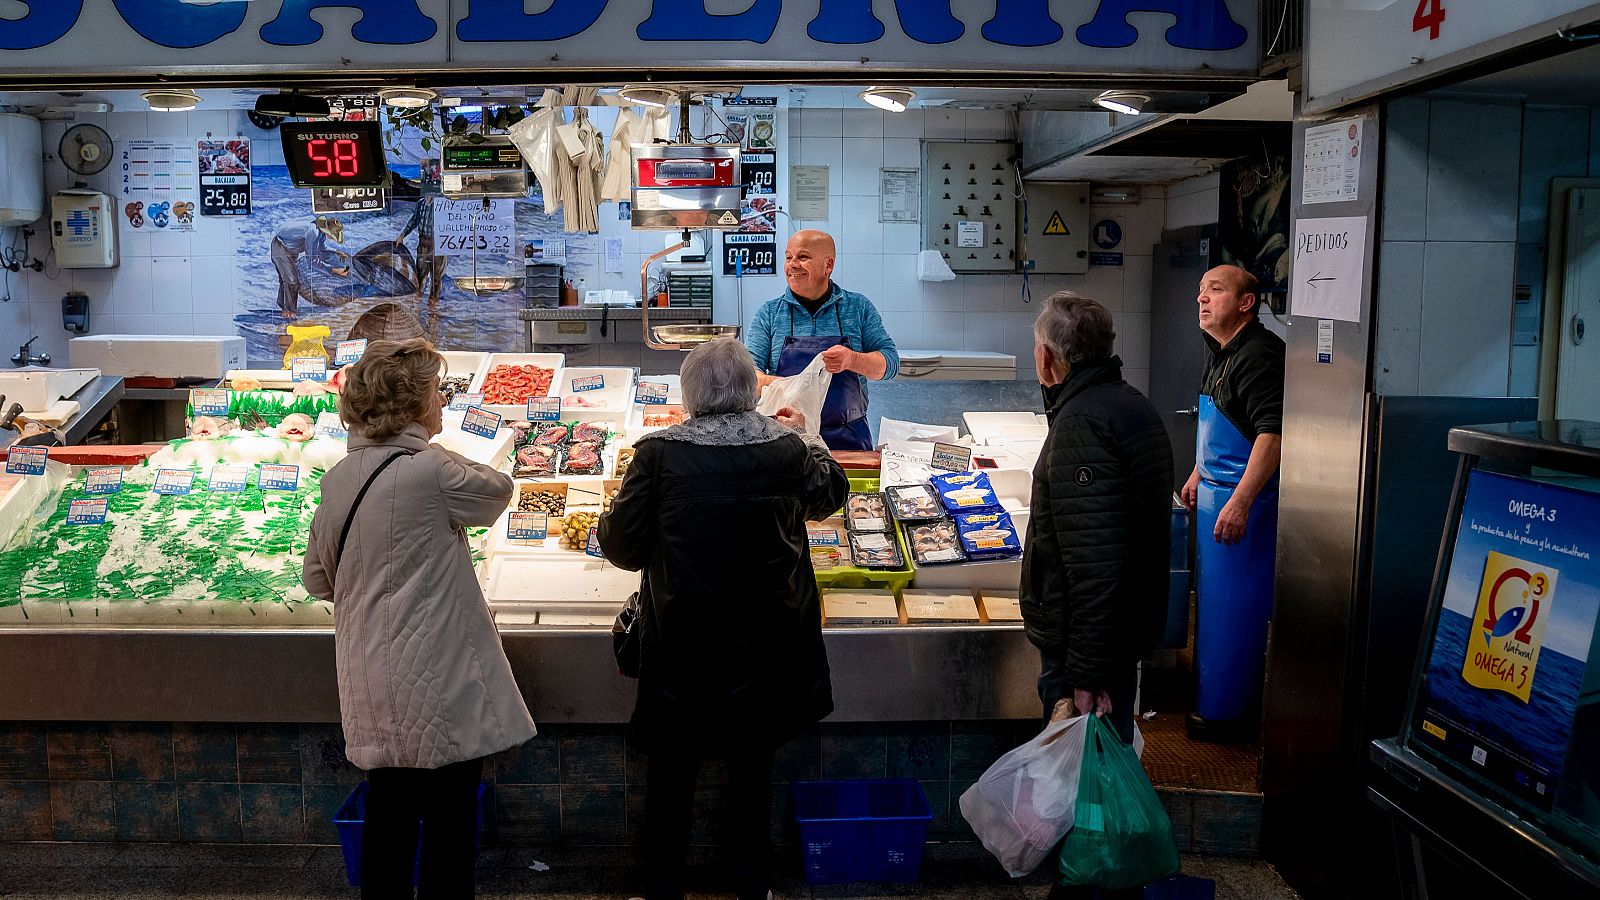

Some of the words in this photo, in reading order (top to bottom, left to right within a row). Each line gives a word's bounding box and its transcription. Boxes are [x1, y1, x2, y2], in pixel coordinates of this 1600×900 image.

[1412, 0, 1446, 40] 4
[307, 140, 358, 177] 58
[204, 189, 247, 208] 25,80
[1296, 230, 1349, 260] PEDIDOS
[1508, 499, 1545, 521] OMEGA
[1547, 509, 1557, 522] 3
[1478, 524, 1505, 538] productos
[1520, 536, 1538, 545] pesca
[1525, 522, 1531, 534] y
[1503, 640, 1534, 660] Natural
[1474, 652, 1516, 683] OMEGA
[1516, 665, 1529, 689] 3
